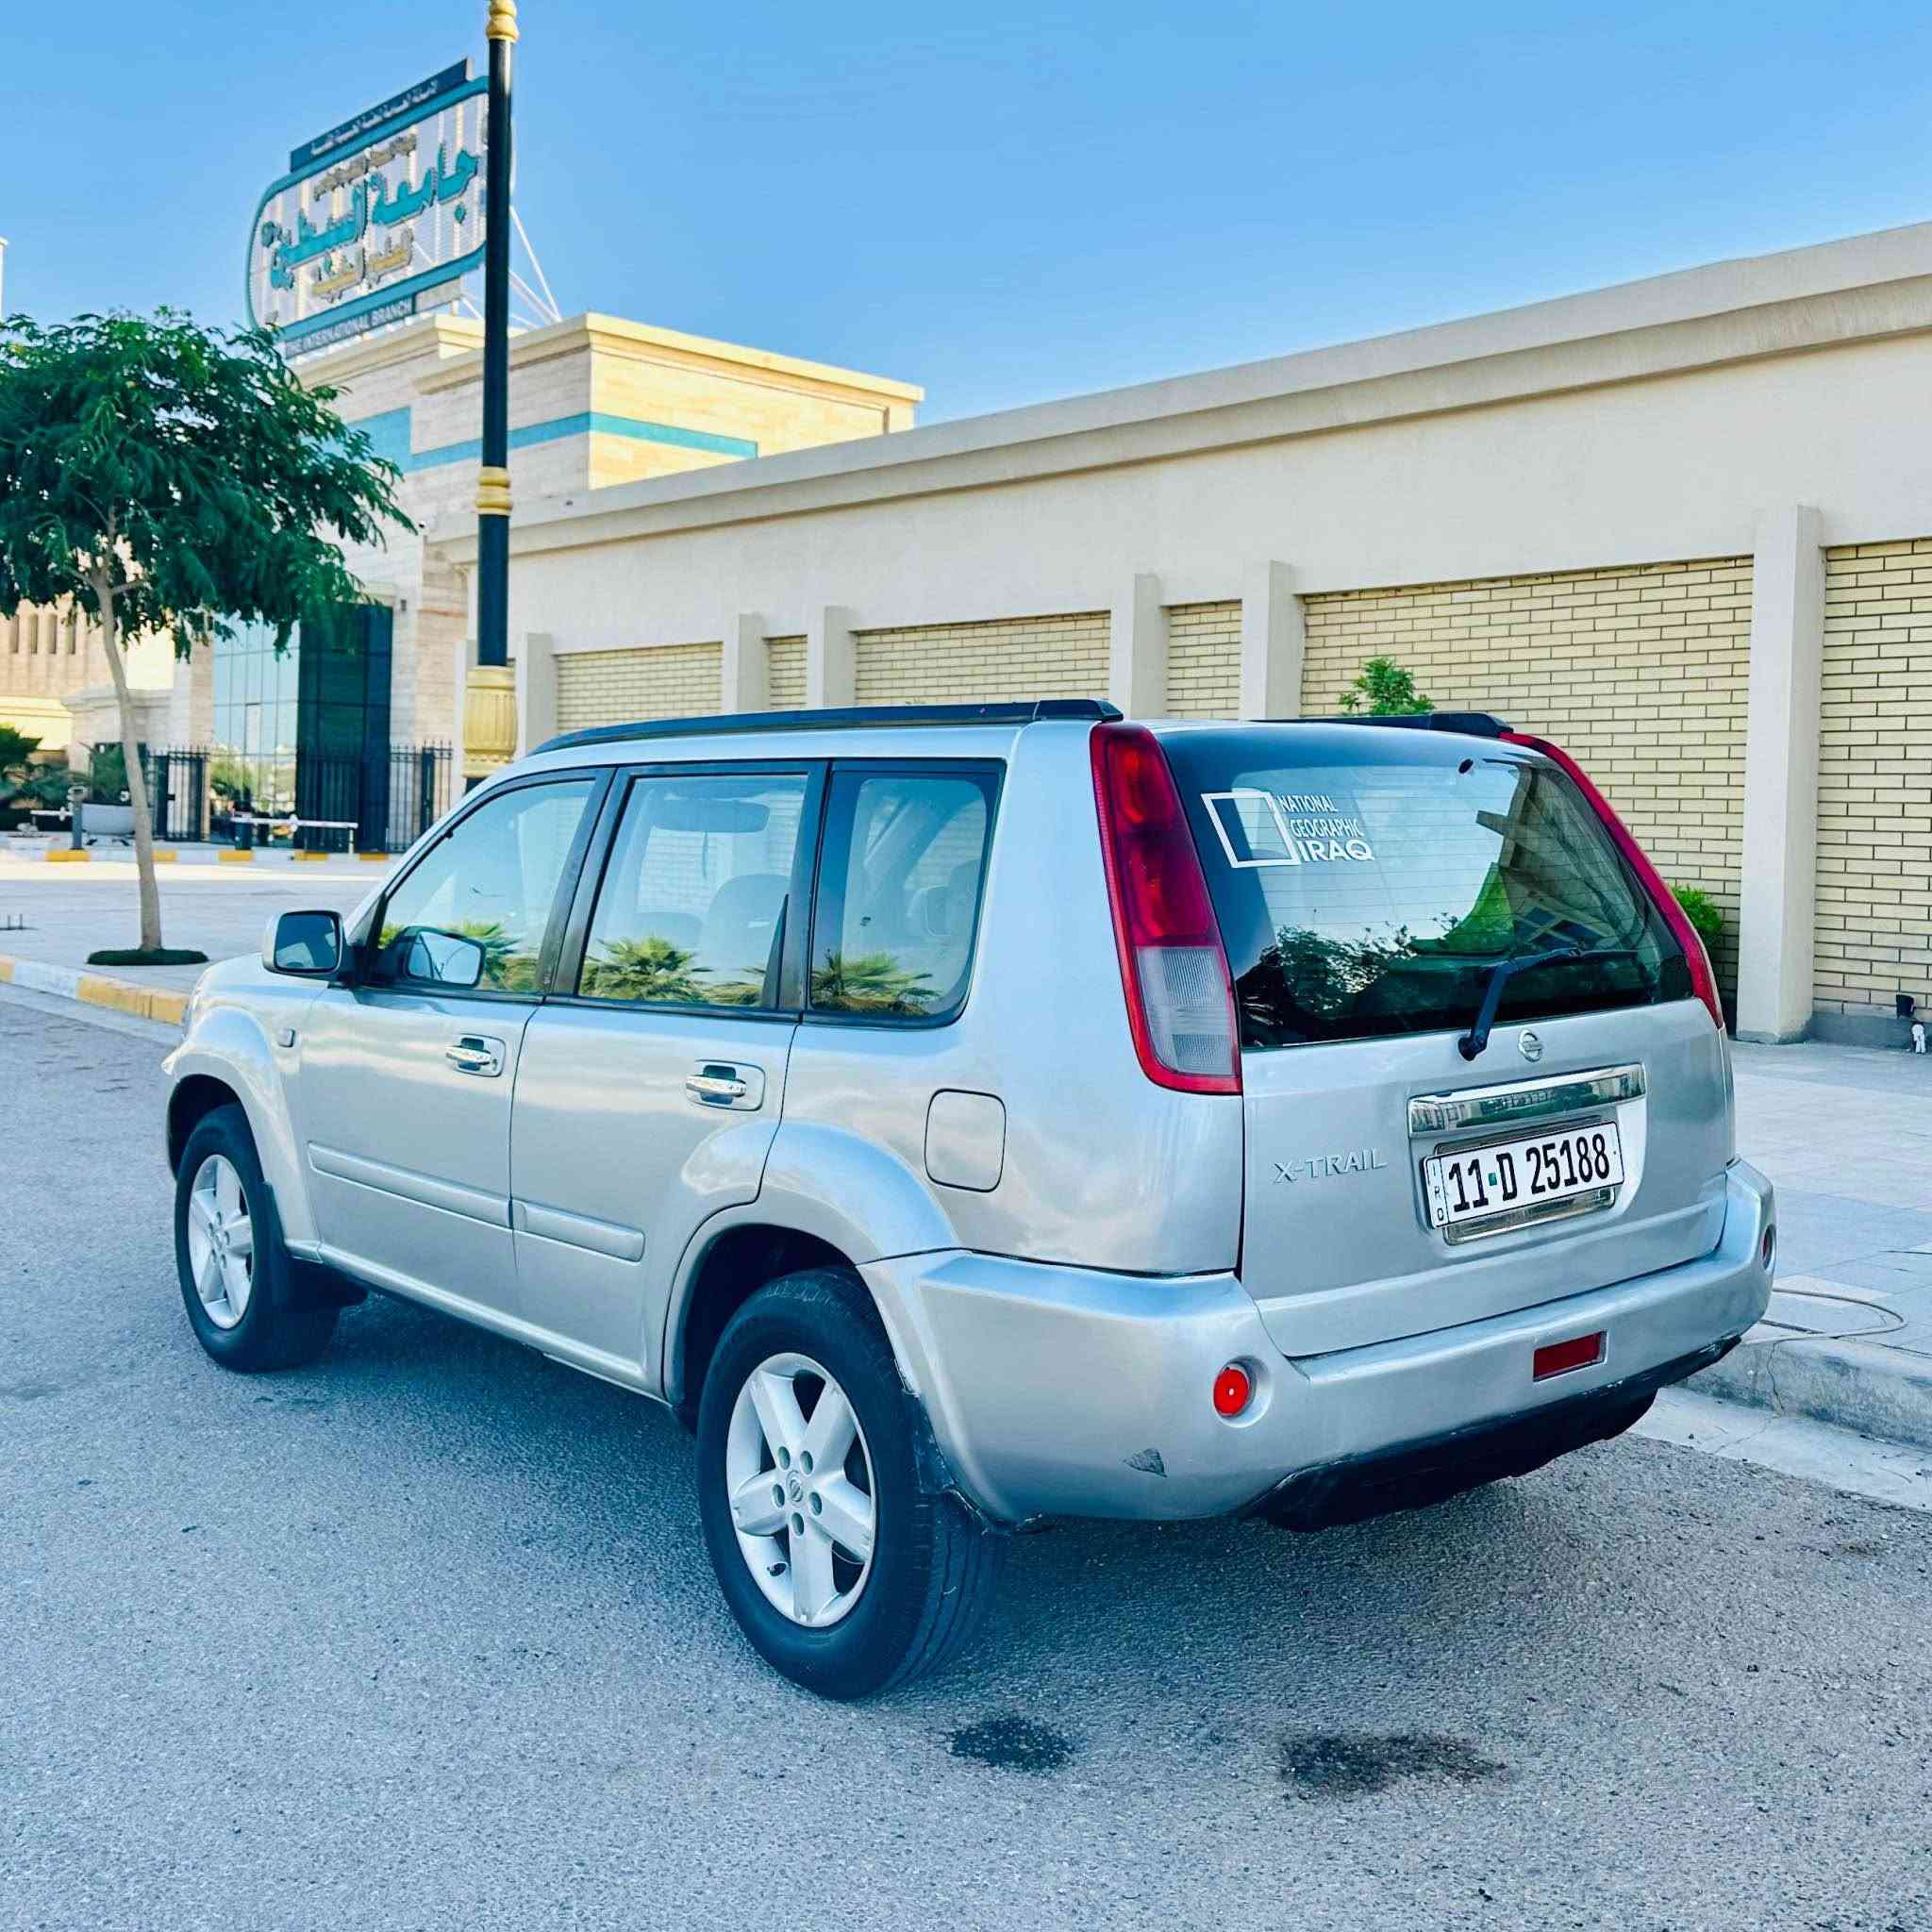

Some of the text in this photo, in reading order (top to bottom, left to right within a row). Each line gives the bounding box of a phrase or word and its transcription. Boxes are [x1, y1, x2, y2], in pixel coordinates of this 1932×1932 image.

[1276, 794, 1338, 812] NATIONAL
[1290, 818, 1364, 838] GEOGRAPHIC
[1298, 840, 1374, 861] IRAQ
[1274, 1148, 1388, 1185] X-TRAIL
[1526, 1133, 1609, 1194] 25188
